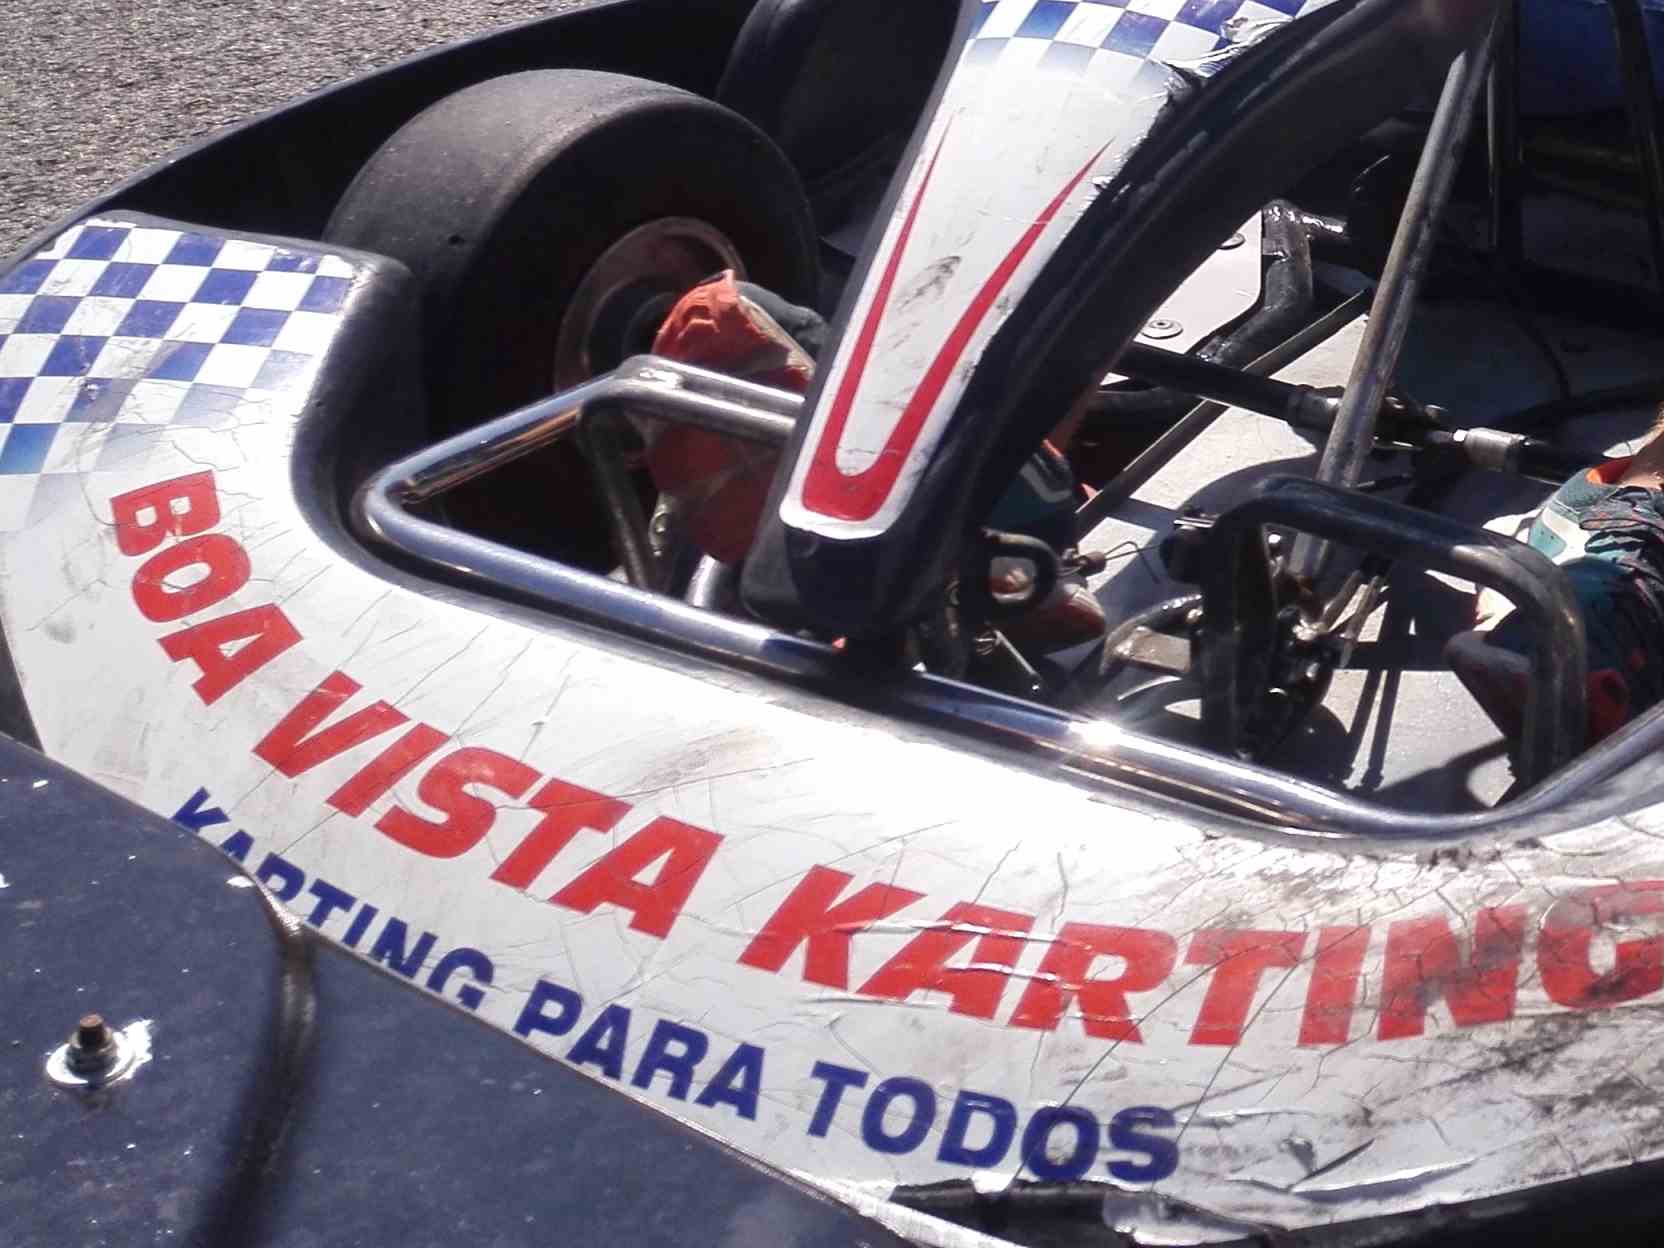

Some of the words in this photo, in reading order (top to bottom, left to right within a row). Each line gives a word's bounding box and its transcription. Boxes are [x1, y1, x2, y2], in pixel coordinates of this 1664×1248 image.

[111, 470, 303, 707] BOA
[252, 670, 725, 941] VISTA
[514, 980, 765, 1121] PARA
[807, 1059, 1181, 1183] TODOS
